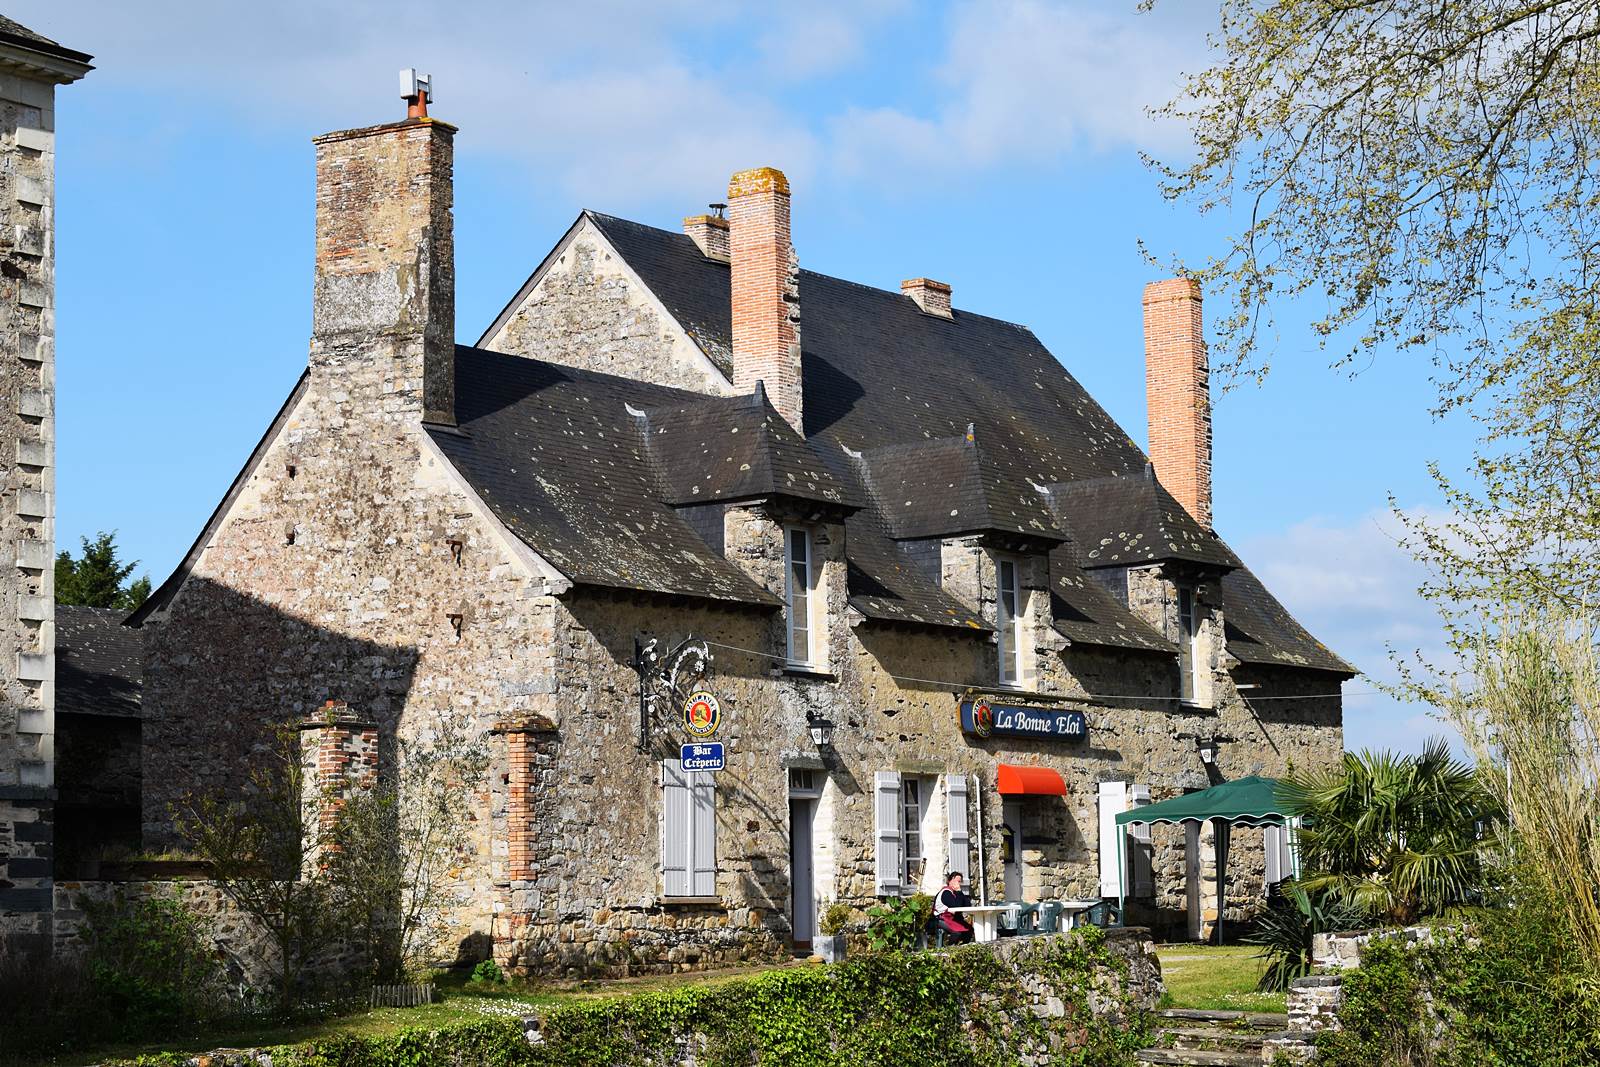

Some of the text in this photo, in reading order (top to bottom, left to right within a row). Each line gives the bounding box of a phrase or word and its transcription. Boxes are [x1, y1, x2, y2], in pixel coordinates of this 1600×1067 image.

[995, 710, 1012, 728] La
[1014, 711, 1051, 733] Bonne
[1056, 714, 1081, 735] Eloi
[692, 746, 712, 757] Bar
[684, 757, 721, 769] Crêperie
